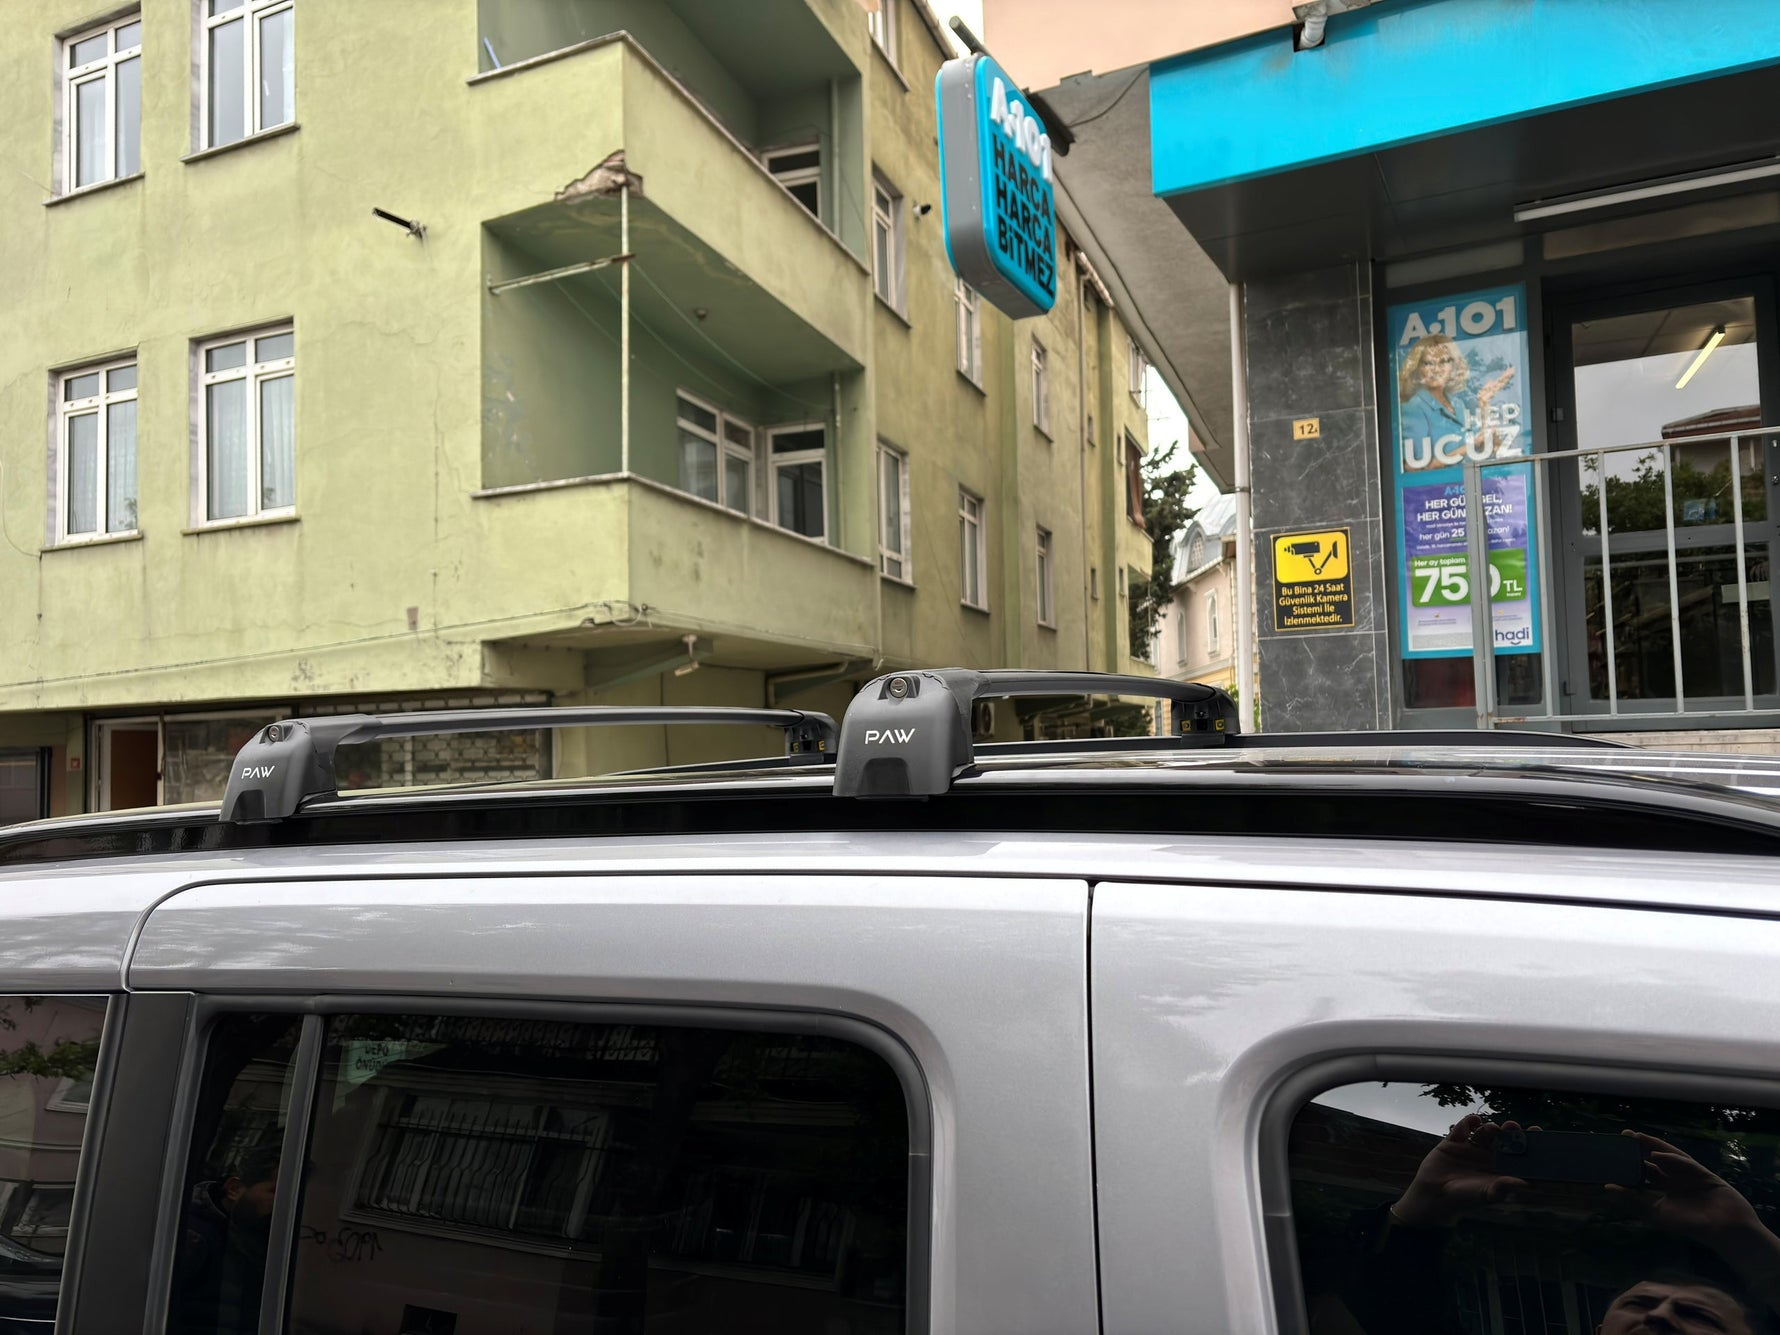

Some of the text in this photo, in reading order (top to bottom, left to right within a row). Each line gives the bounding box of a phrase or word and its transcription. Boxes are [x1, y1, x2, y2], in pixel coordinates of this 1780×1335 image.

[993, 133, 1052, 225] HARCA
[996, 173, 1053, 261] HARCA
[1404, 425, 1522, 468] UCUZ
[1425, 499, 1448, 510] HER
[1450, 495, 1466, 507] GÜ
[1417, 504, 1512, 522] HER GÜN ZAN!
[1419, 533, 1433, 541] her
[1434, 530, 1450, 541] gün
[1451, 527, 1465, 538] 25
[1440, 557, 1466, 566] toplam
[1281, 583, 1344, 596] Bu Bina 24 Saat
[1503, 579, 1523, 591] TL
[1279, 594, 1348, 606] Güvenlik Kamera
[1292, 604, 1322, 615] Sistemi
[1495, 627, 1529, 641] hadi
[864, 728, 916, 745] PAW
[241, 765, 275, 780] PAW
